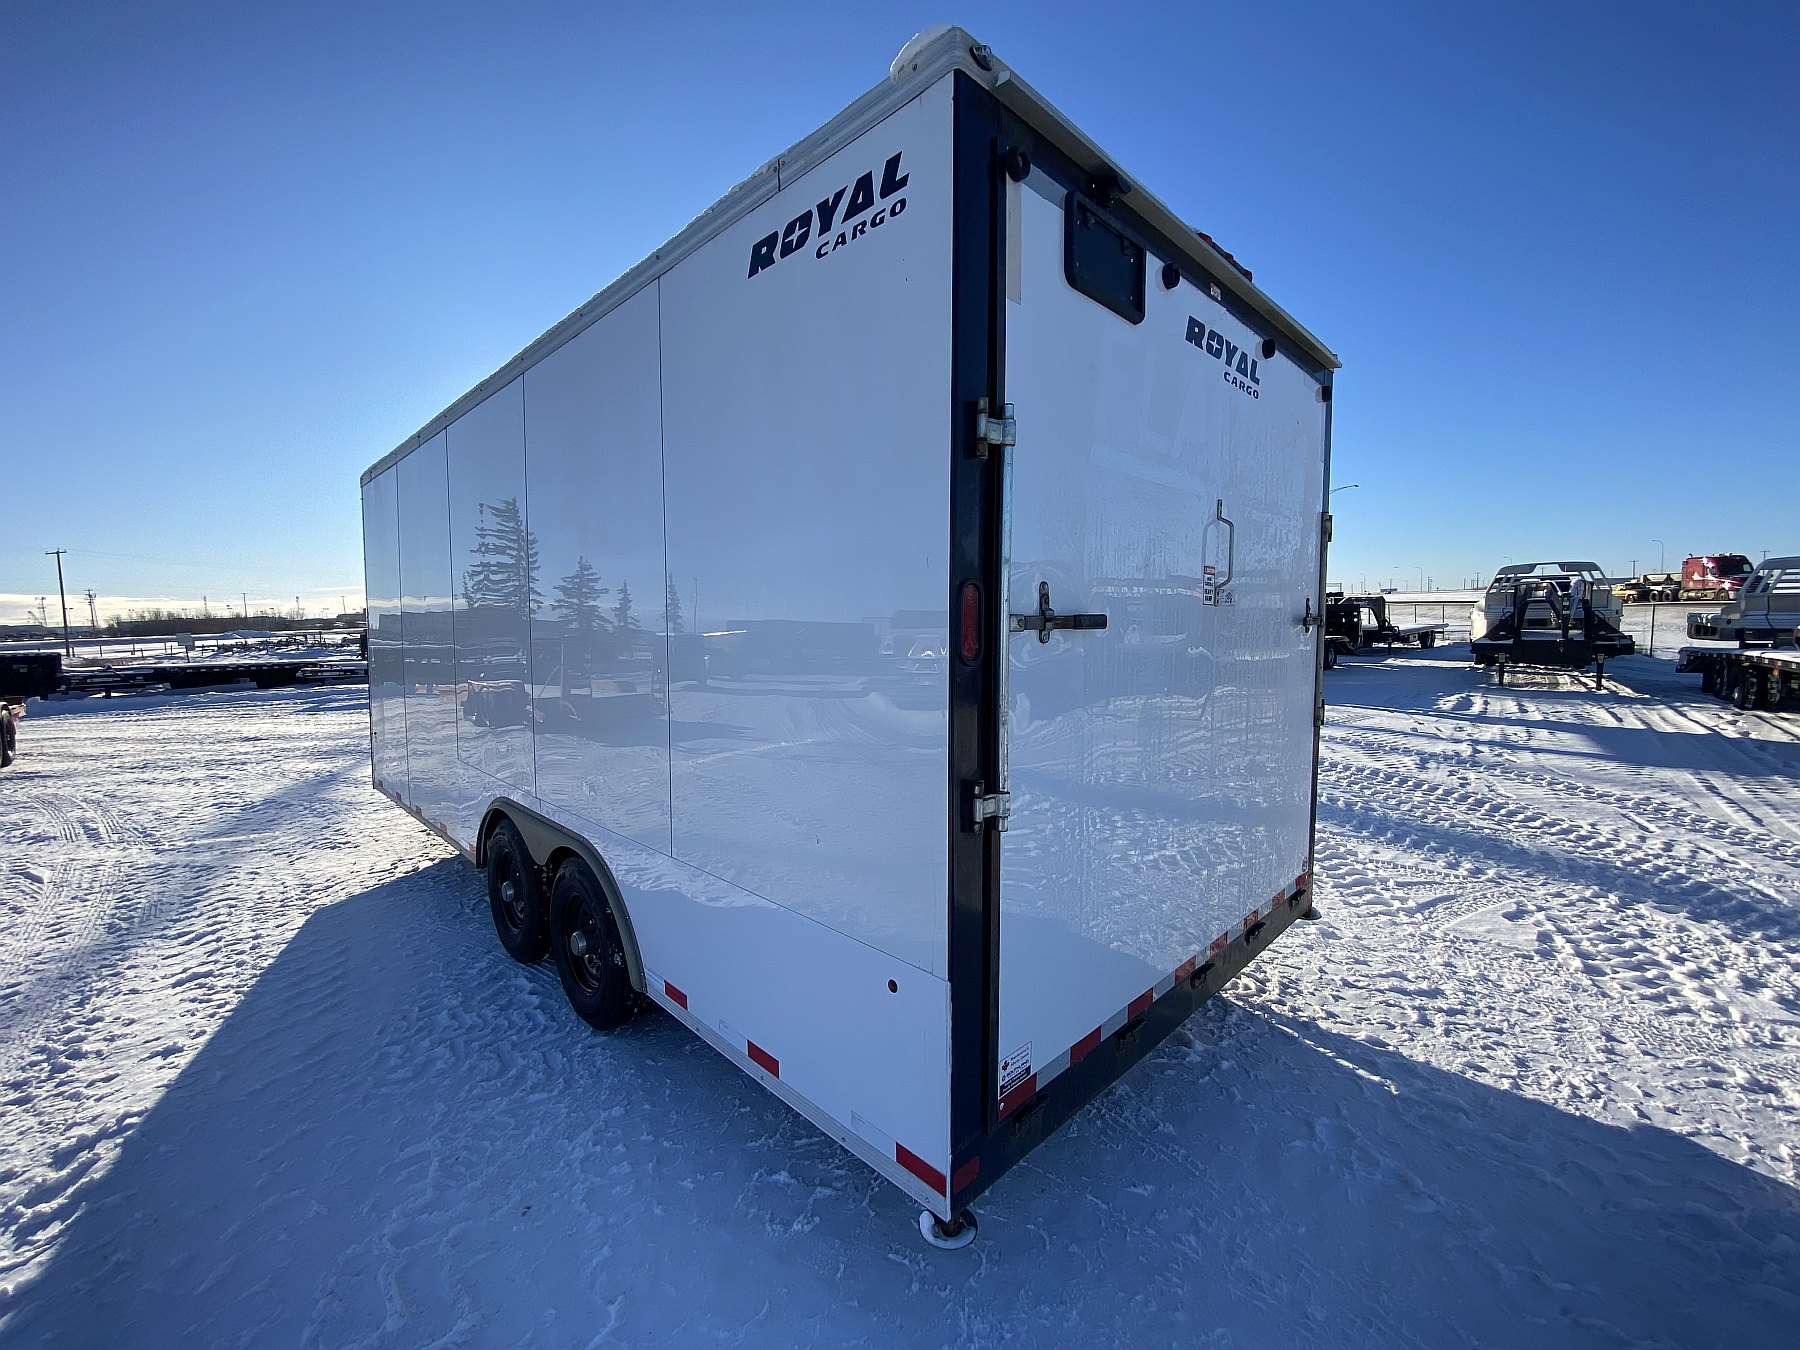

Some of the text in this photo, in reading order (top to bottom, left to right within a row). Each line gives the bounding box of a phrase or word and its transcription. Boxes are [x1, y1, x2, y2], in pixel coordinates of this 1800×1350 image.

[748, 151, 910, 279] ROYAL
[815, 198, 907, 259] CARGO
[1185, 315, 1260, 386] ROYAL
[1223, 371, 1259, 400] CARGO
